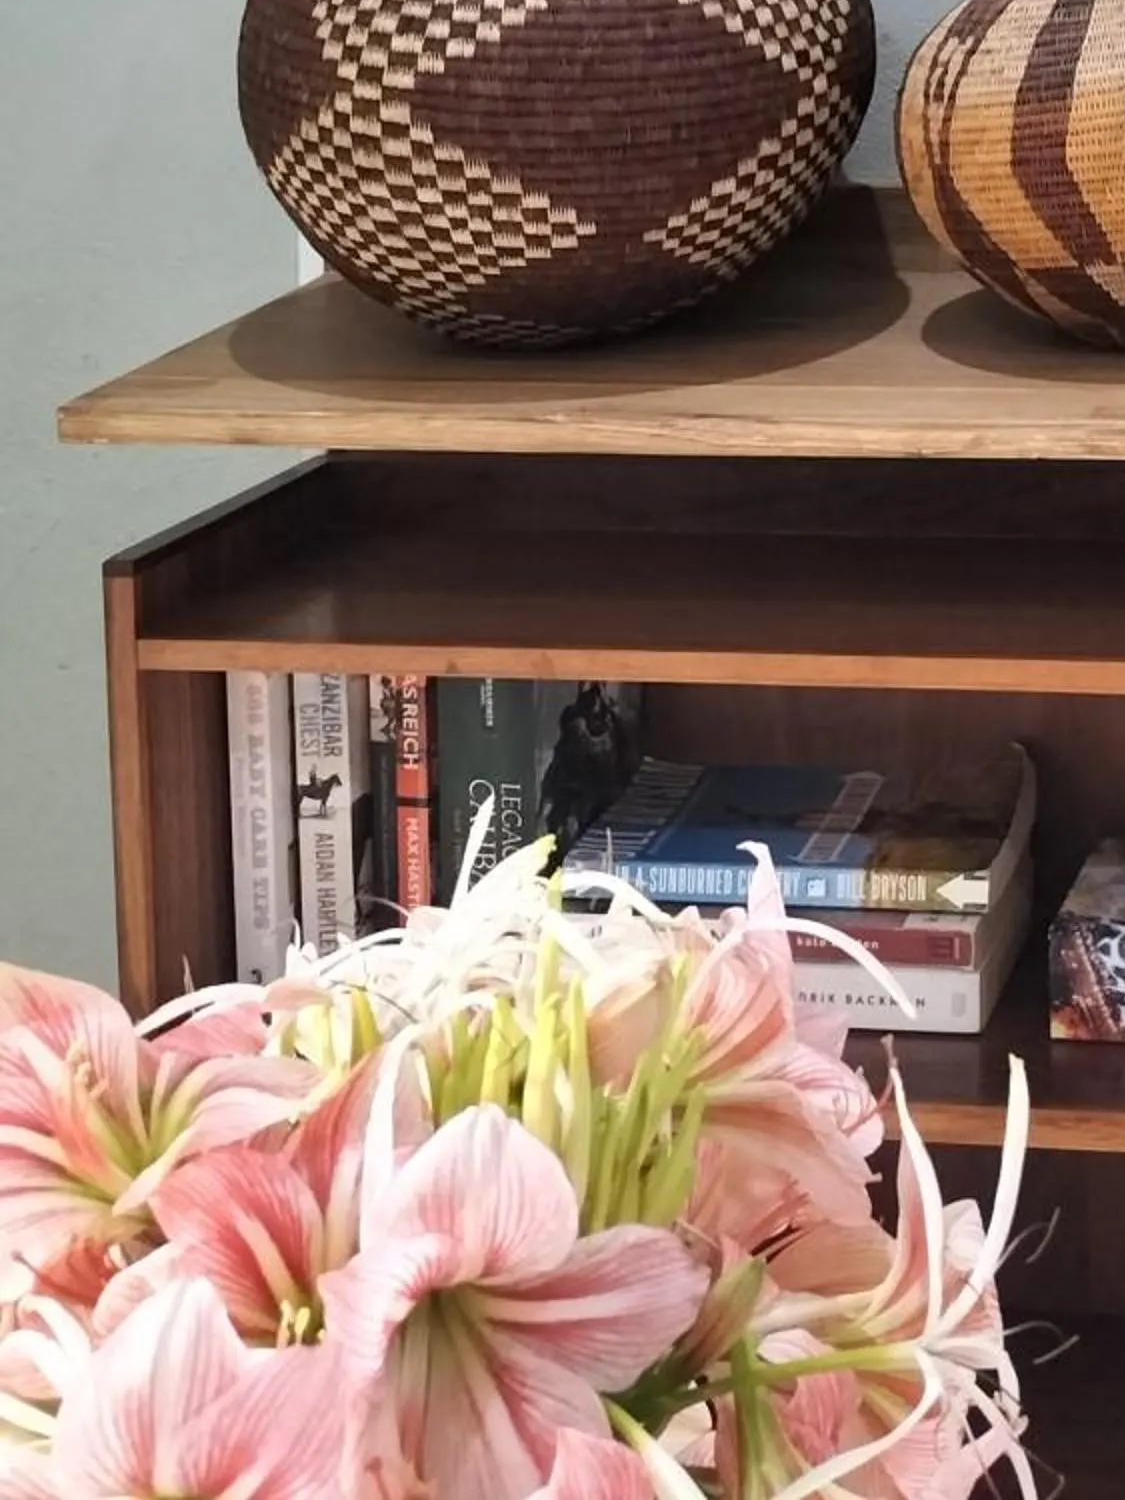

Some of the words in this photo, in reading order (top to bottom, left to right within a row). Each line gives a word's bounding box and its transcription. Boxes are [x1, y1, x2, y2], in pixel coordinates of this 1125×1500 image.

[401, 674, 418, 700] AS
[300, 703, 321, 758] CHEST
[320, 673, 343, 758] ZANZIBAR
[402, 702, 420, 770] REICH
[250, 807, 268, 869] CARE
[406, 816, 422, 858] MAX
[500, 782, 523, 860] LEGAC
[315, 832, 335, 883] AIDAN
[649, 866, 734, 895] SUNBURNED
[836, 873, 866, 901] BILL
[870, 873, 928, 902] BRYSON
[799, 991, 836, 1005] DRIK
